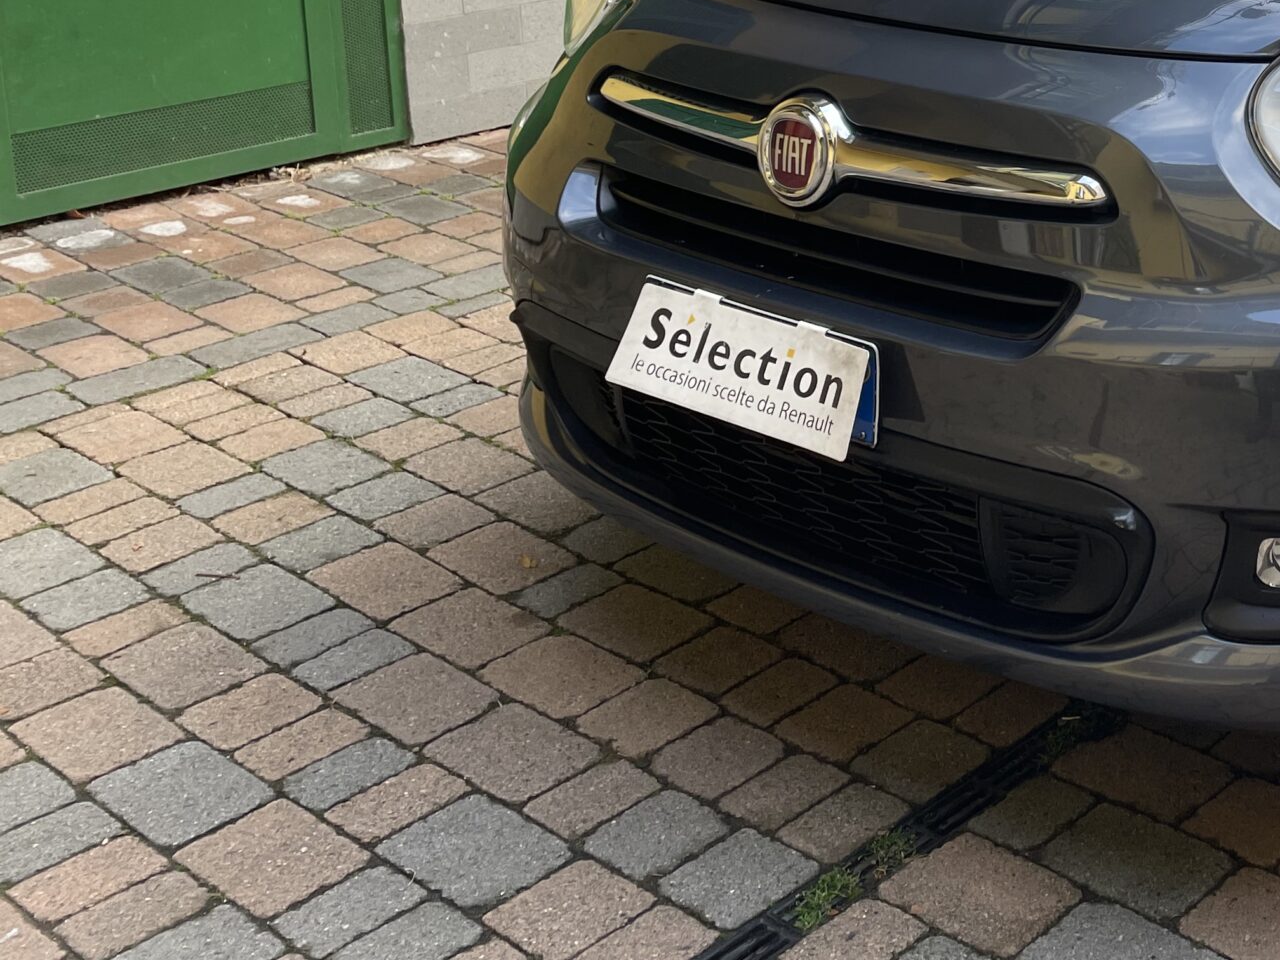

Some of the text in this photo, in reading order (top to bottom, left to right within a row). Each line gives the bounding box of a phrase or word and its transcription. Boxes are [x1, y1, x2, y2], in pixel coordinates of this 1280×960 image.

[774, 132, 812, 176] FIAT
[630, 352, 835, 436] le occasioni scelte da Renault
